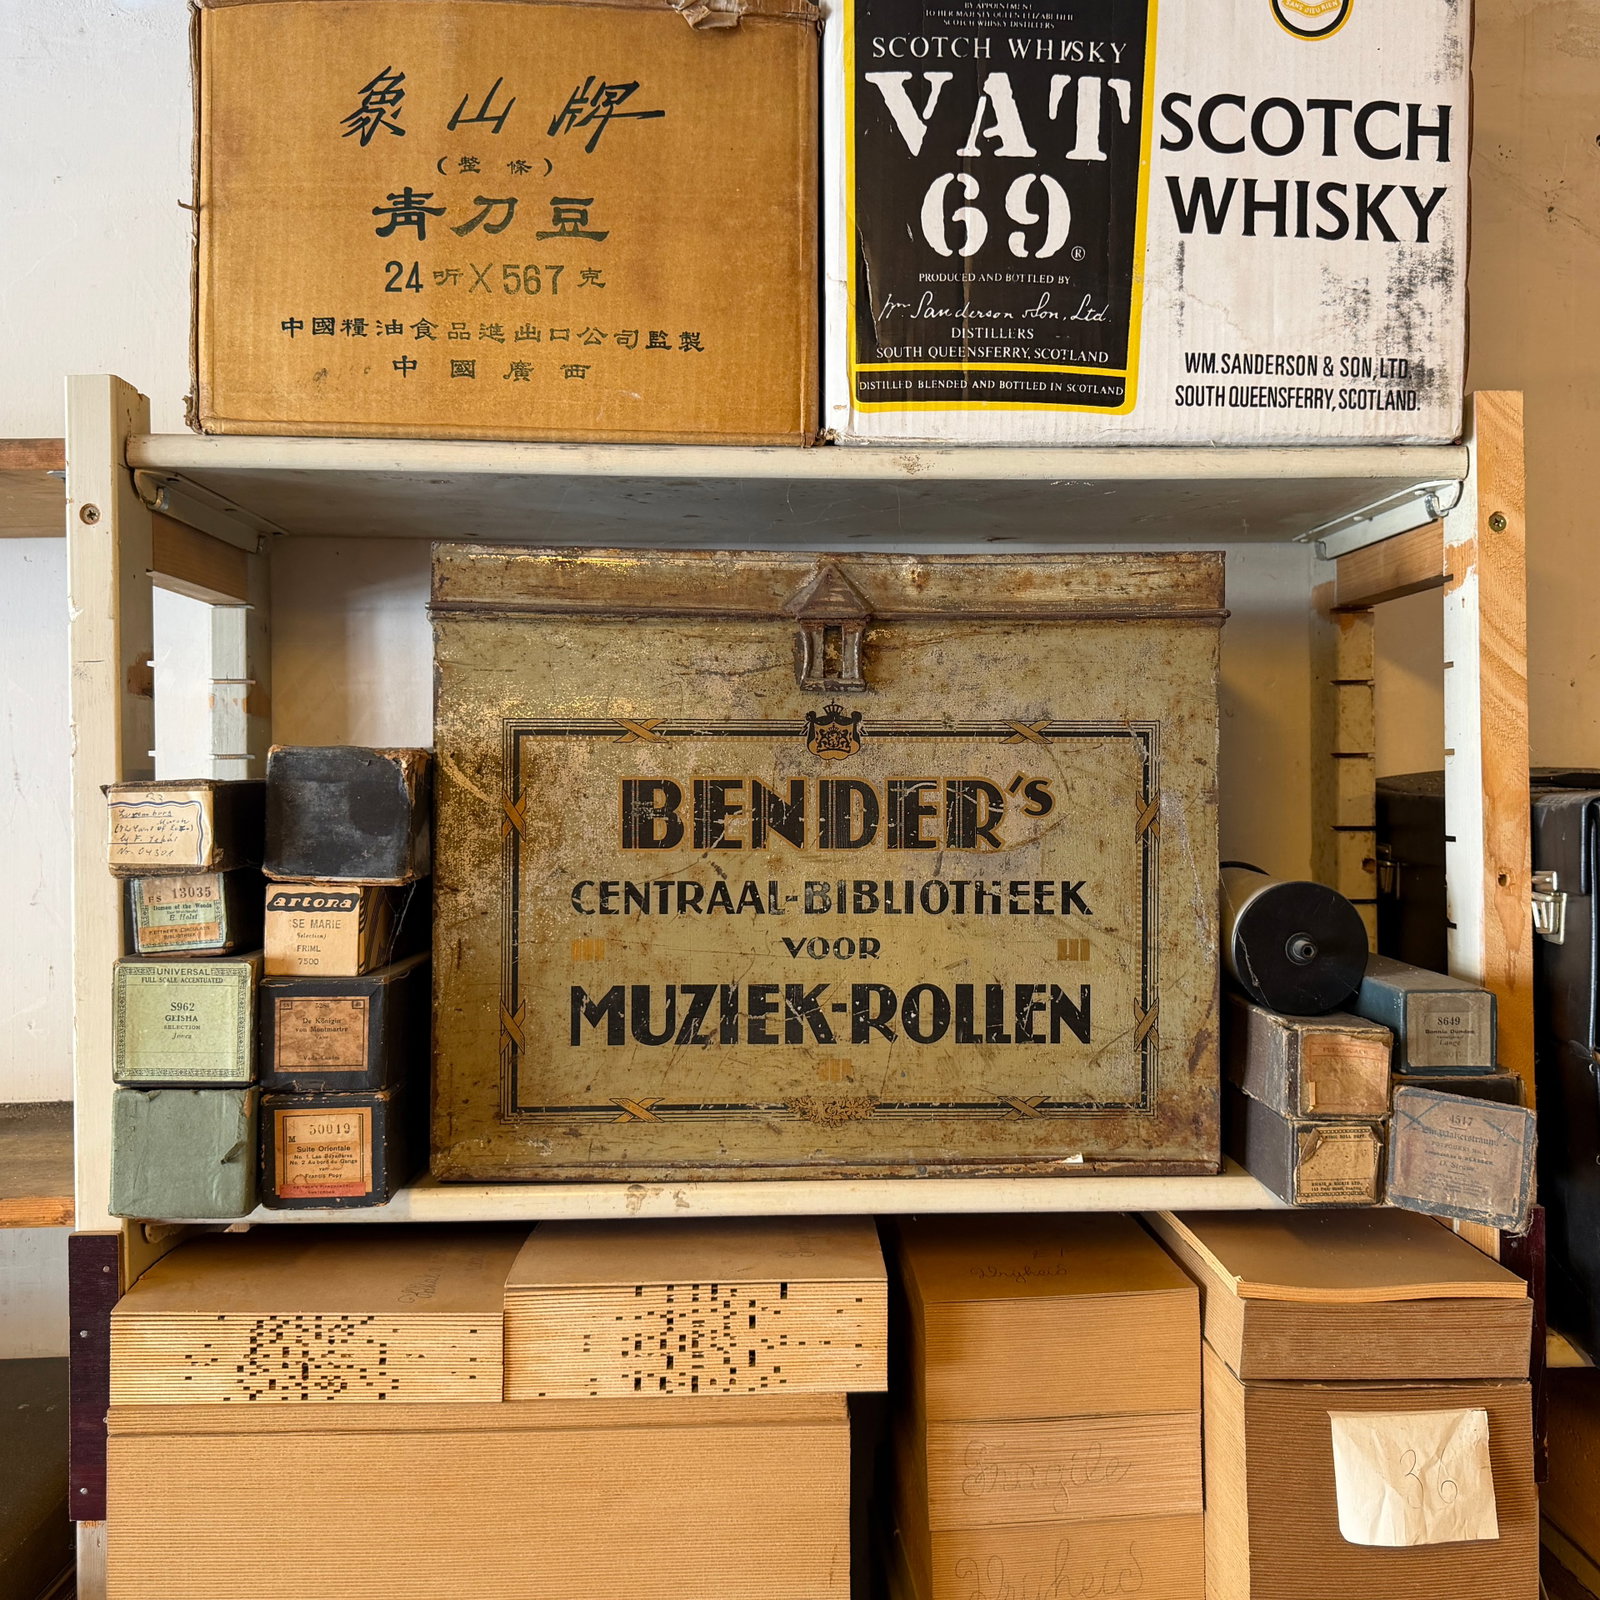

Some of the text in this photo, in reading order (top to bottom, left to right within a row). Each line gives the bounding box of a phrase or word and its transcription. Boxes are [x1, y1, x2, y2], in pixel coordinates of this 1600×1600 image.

[943, 19, 975, 27] SCOTCH
[1010, 21, 1055, 29] DISTILLERS
[872, 36, 1127, 63] SCOTCH WHISKY
[864, 71, 1131, 162] VAT
[1159, 92, 1452, 163] SCOTCH
[920, 173, 1072, 258] 69
[1165, 175, 1447, 243] WHISKY
[919, 272, 1071, 285] PRODUCED AND BOTTLED BY
[910, 290, 1014, 319] Sanderson
[1070, 293, 1112, 322] Ltd.
[951, 327, 1035, 340] DISTILLERS
[876, 346, 1109, 364] SOUTH QUEENSFERRY, SCOTLAND
[1322, 356, 1334, 378] &
[859, 379, 1124, 396] DISTILLED BLENDED AND BOTTLED IN SCOTLAND
[1175, 385, 1226, 407] SOUTH
[172, 886, 212, 899] 13035
[570, 880, 1094, 915] CENTRAAL-BIBLIOTHEEK
[273, 896, 353, 908] artona
[289, 919, 341, 929] SE MARIE
[296, 944, 321, 953] FRIML
[781, 936, 881, 960] VOOR
[298, 957, 320, 965] 7500
[141, 976, 157, 984] FULL
[156, 968, 211, 976] UNIVERSAL
[164, 1014, 199, 1022] GEISHA
[570, 983, 1091, 1047] MUZIEK-ROLLEN
[288, 1135, 296, 1143] M
[1399, 1447, 1459, 1510] 36
